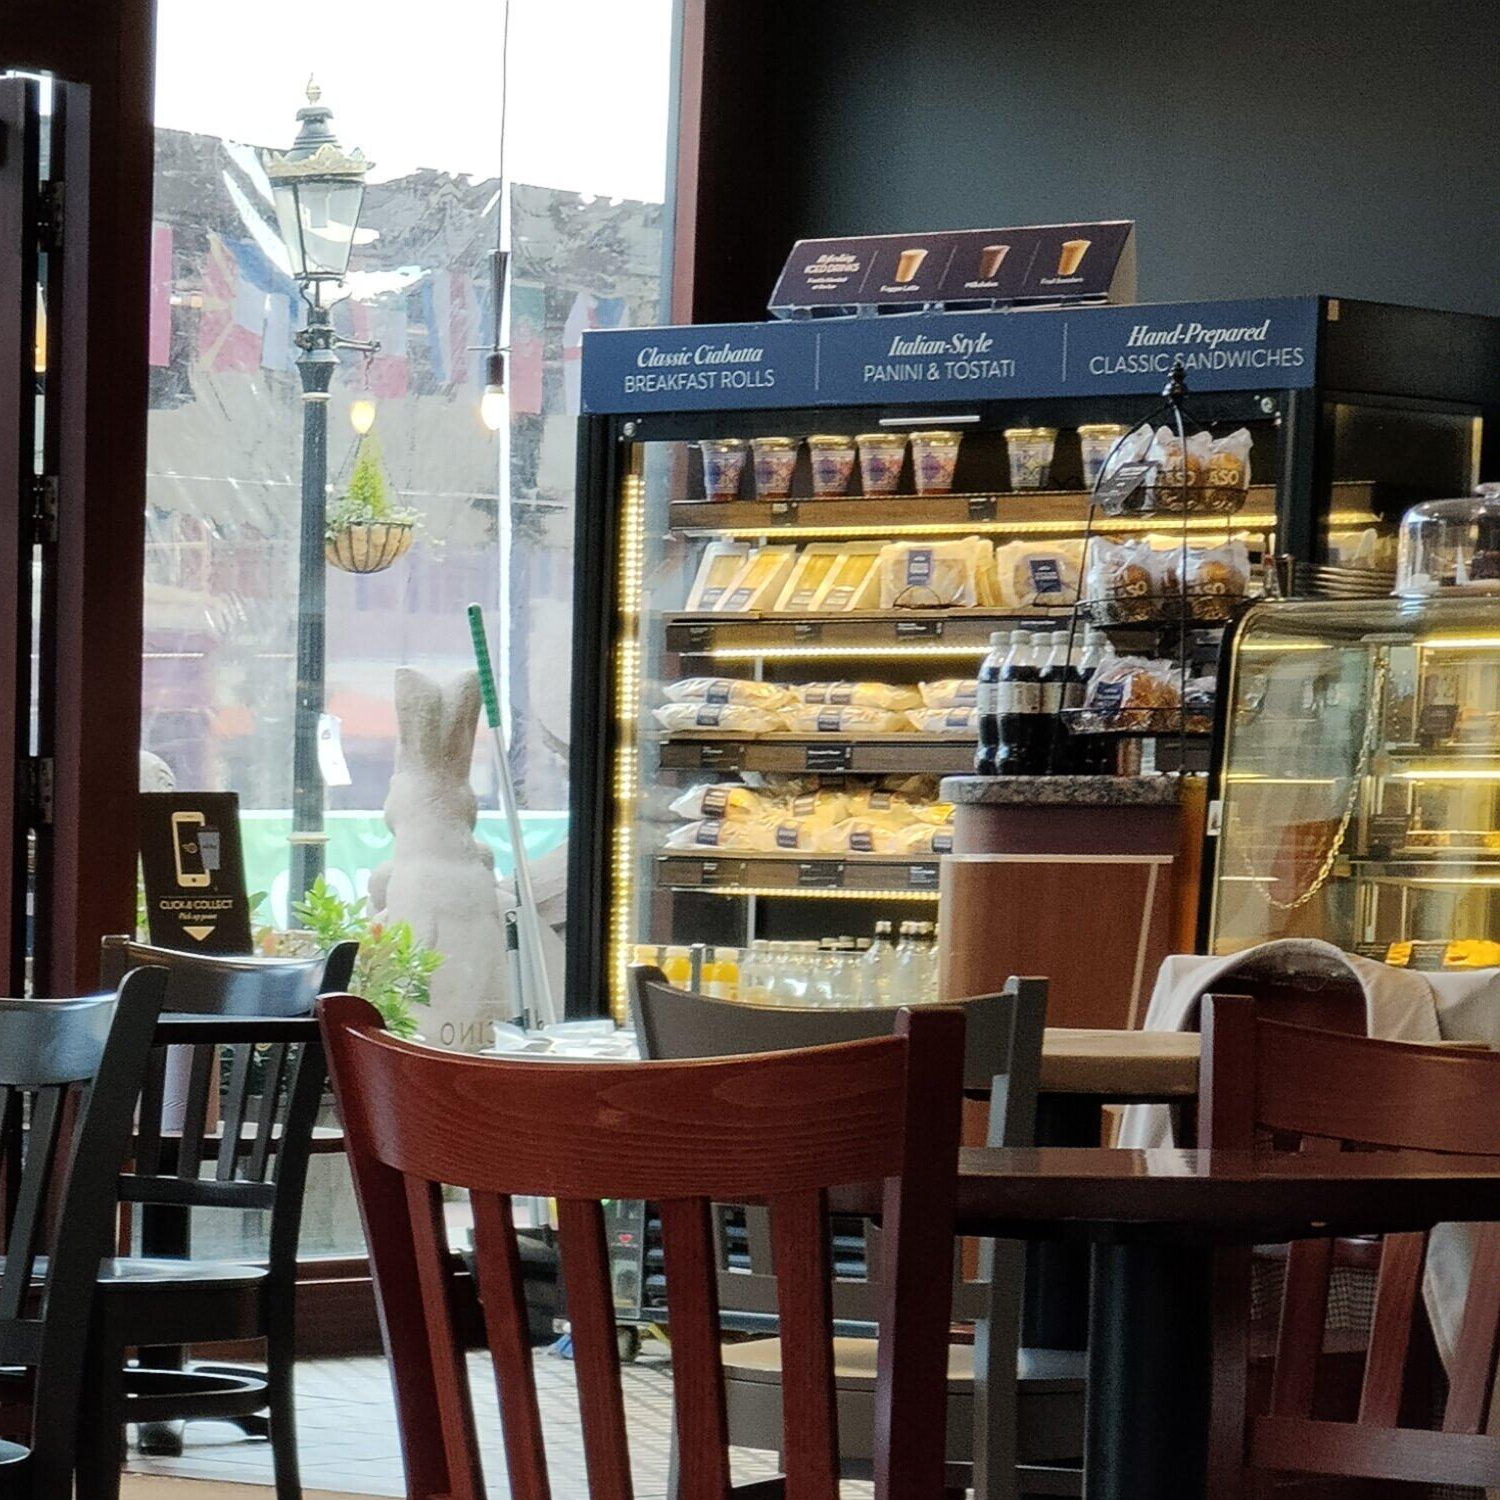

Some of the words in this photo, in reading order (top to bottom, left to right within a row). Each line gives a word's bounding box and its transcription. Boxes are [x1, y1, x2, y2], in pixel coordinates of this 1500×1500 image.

[888, 332, 994, 360] Italian-Style
[1126, 319, 1271, 350] Hand-Prepared
[637, 346, 694, 368] Classic
[694, 343, 764, 365] Ciabatta
[1089, 353, 1170, 376] CLASSIC
[1173, 347, 1305, 371] SANDWICHES
[624, 370, 717, 393] BREAKFAST
[721, 368, 776, 389] ROLLS
[864, 363, 924, 383] PANINI
[927, 362, 940, 381] &
[945, 359, 1016, 380] TOSTATI
[193, 900, 234, 910] COLLECT
